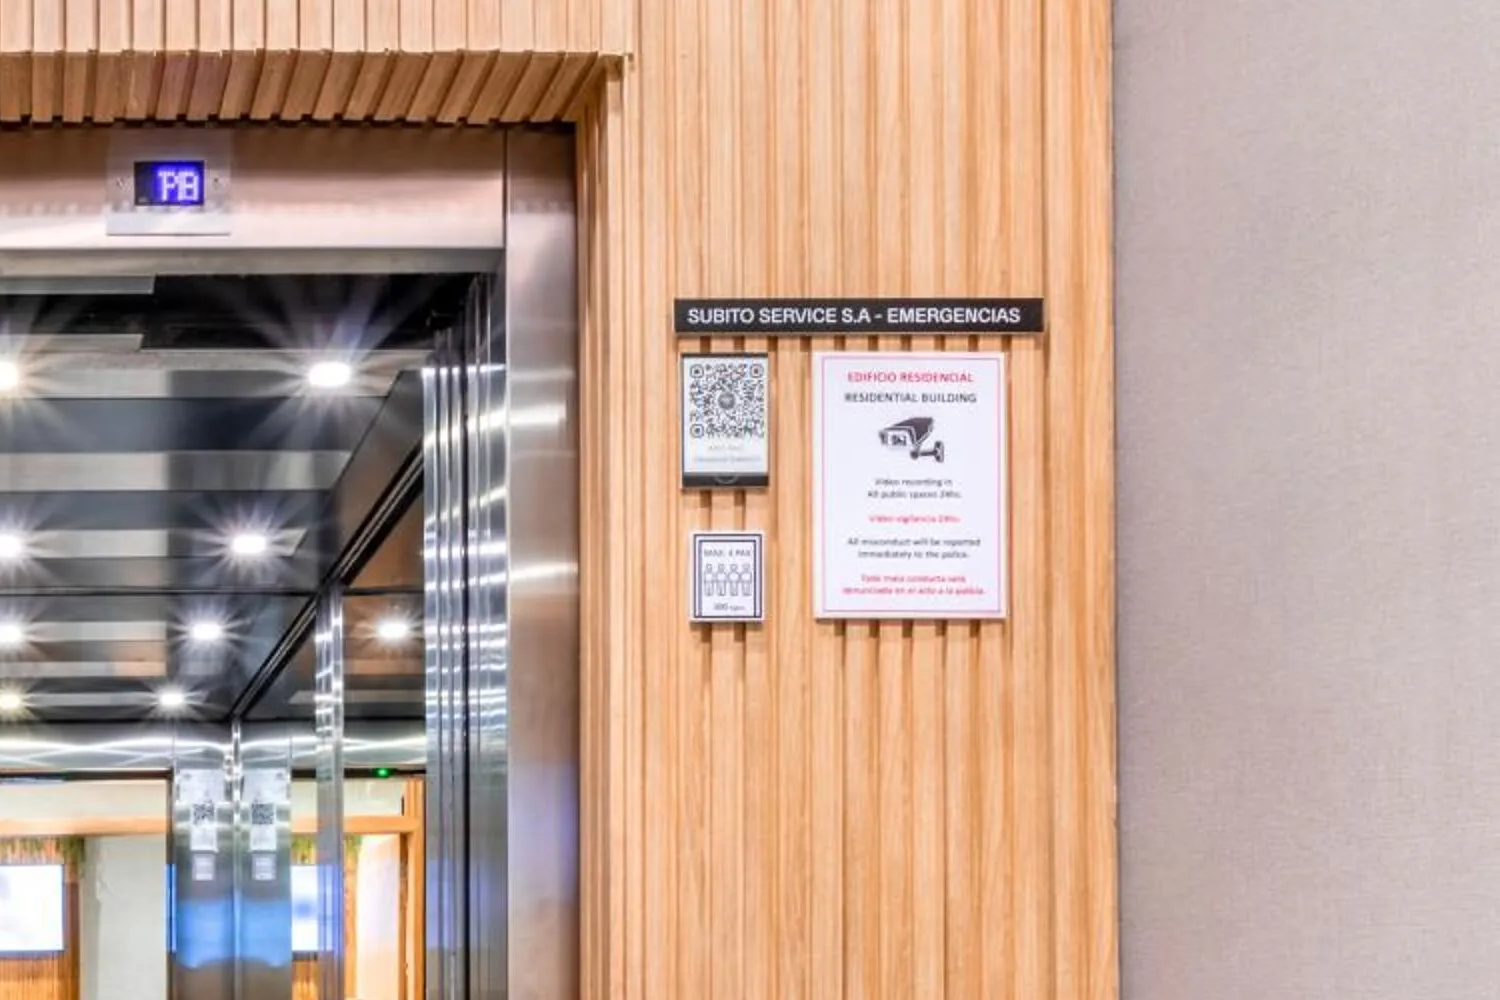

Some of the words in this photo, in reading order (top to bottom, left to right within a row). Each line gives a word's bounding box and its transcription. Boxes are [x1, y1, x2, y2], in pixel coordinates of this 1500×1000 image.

[157, 170, 199, 201] PB
[687, 308, 755, 324] SUBITO
[758, 308, 837, 324] SERVICE
[841, 308, 871, 324] S.A
[887, 308, 1021, 324] EMERGENCIAS
[847, 372, 897, 383] EDIFICIO
[899, 372, 974, 383] RESIDENCIAL
[844, 392, 918, 403] RESIDENTIAL
[921, 392, 977, 403] BUILDING
[875, 478, 900, 486] Video
[901, 478, 942, 487] recording
[861, 537, 911, 546] misconduct
[913, 537, 929, 545] will
[930, 537, 941, 545] be
[943, 537, 981, 547] reported
[858, 550, 912, 559] immediately
[914, 550, 923, 558] to
[925, 550, 940, 558] the
